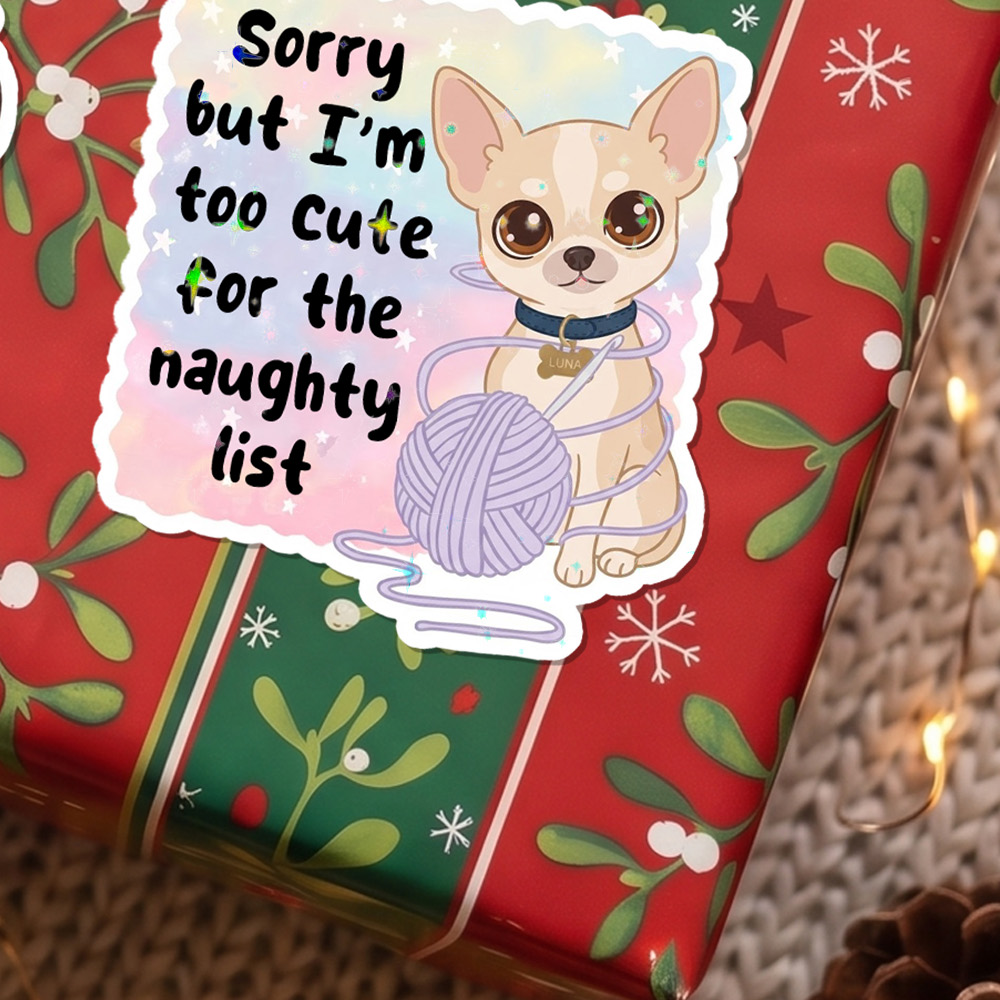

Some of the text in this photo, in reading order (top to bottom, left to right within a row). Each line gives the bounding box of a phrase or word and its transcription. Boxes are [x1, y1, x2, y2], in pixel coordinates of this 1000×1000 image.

[232, 9, 405, 101] Sorry
[186, 78, 426, 173] but I'm
[175, 166, 433, 259] too cute
[176, 256, 402, 339] for the
[149, 346, 401, 442] naughty
[549, 357, 582, 370] LUNA
[211, 425, 312, 496] list
